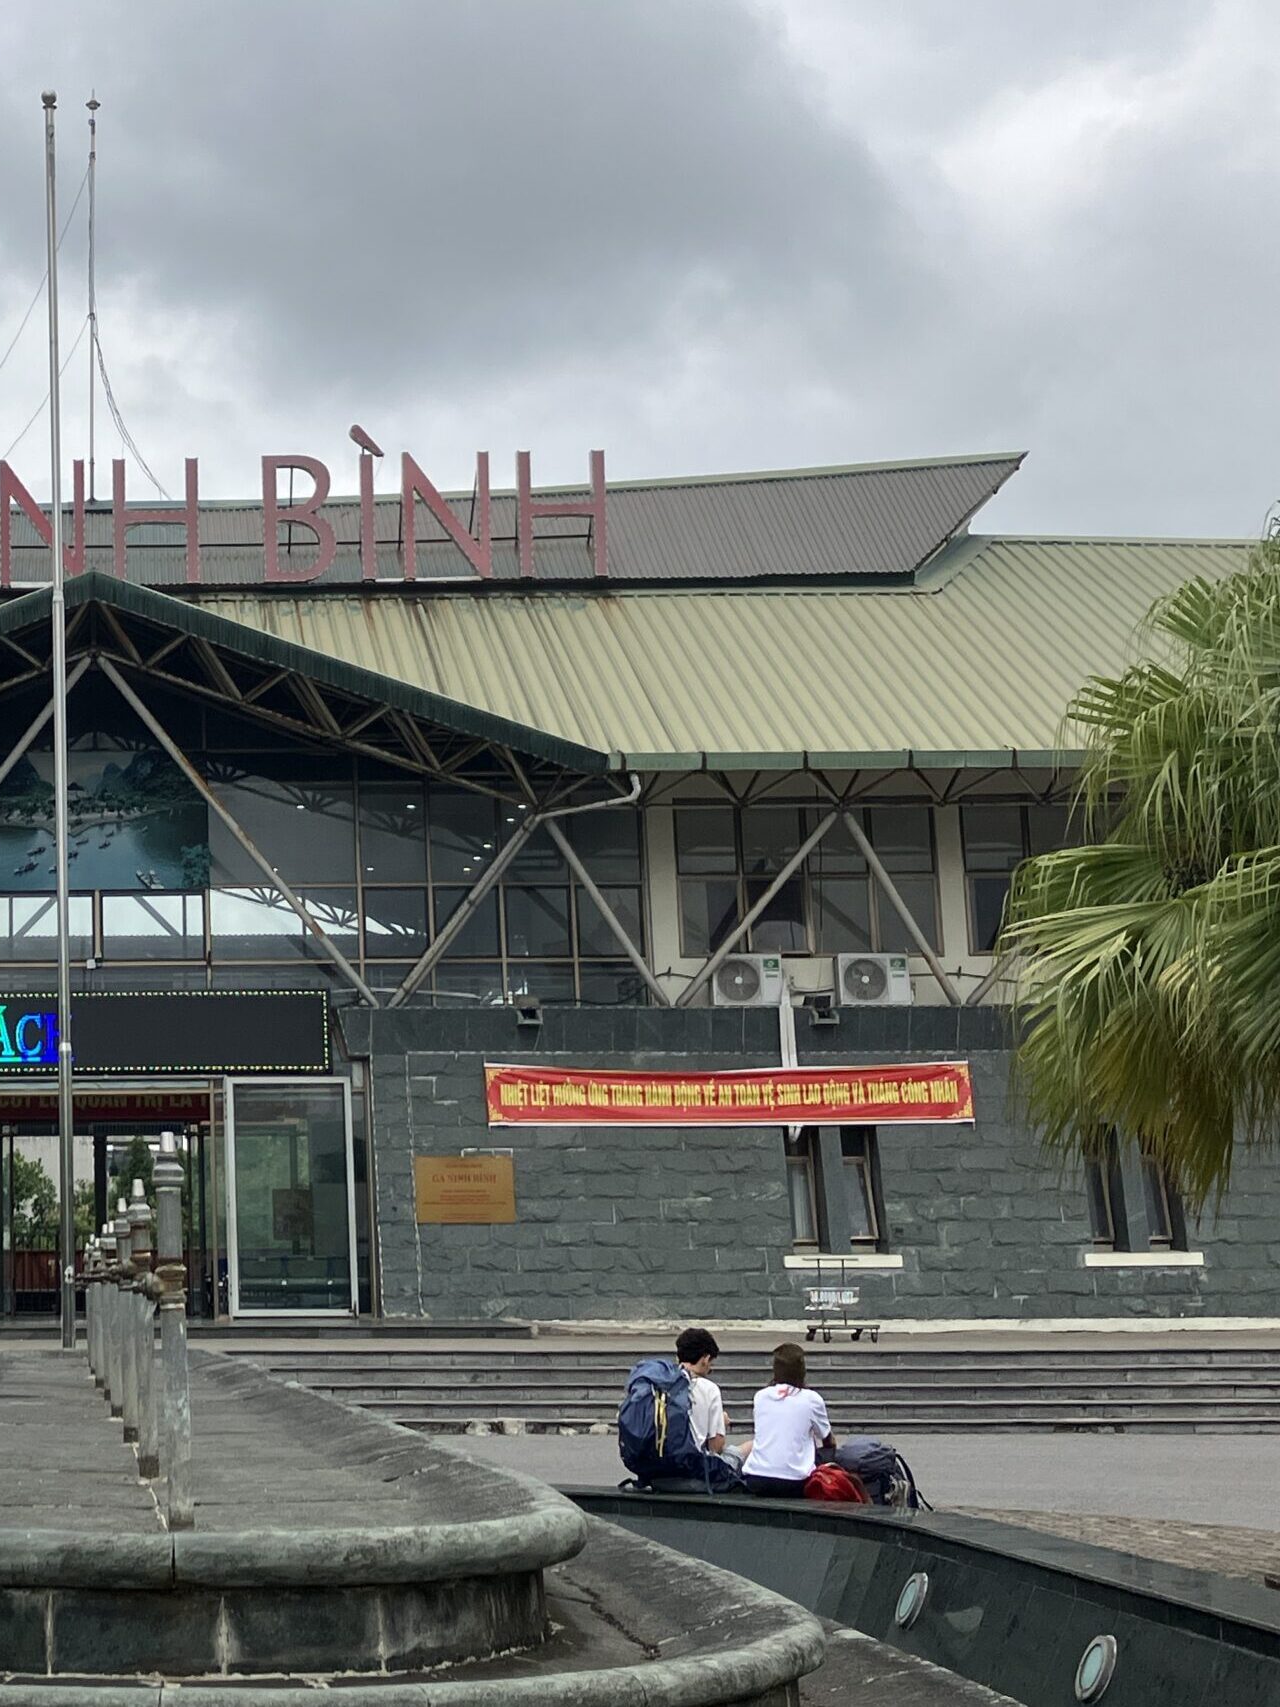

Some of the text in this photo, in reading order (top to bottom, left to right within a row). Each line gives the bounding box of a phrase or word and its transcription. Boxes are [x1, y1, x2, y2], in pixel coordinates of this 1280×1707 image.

[261, 424, 608, 583] BÌNH
[500, 1079, 528, 1111] NHIỆT
[530, 1080, 550, 1111] LIỆT
[610, 1080, 643, 1107] THÁNG
[645, 1081, 672, 1107] HÀNH
[673, 1081, 702, 1112] ĐỘNG
[718, 1084, 732, 1107] AN
[733, 1079, 760, 1106] TOÀN
[762, 1079, 776, 1111] VỆ
[777, 1083, 801, 1105] SINH
[802, 1083, 822, 1105] LAO
[823, 1078, 851, 1112] ĐỘNG
[851, 1078, 866, 1105] VÀ
[867, 1077, 900, 1104] THÁNG
[900, 1076, 929, 1104] CÔNG
[930, 1076, 959, 1104] NHÂN
